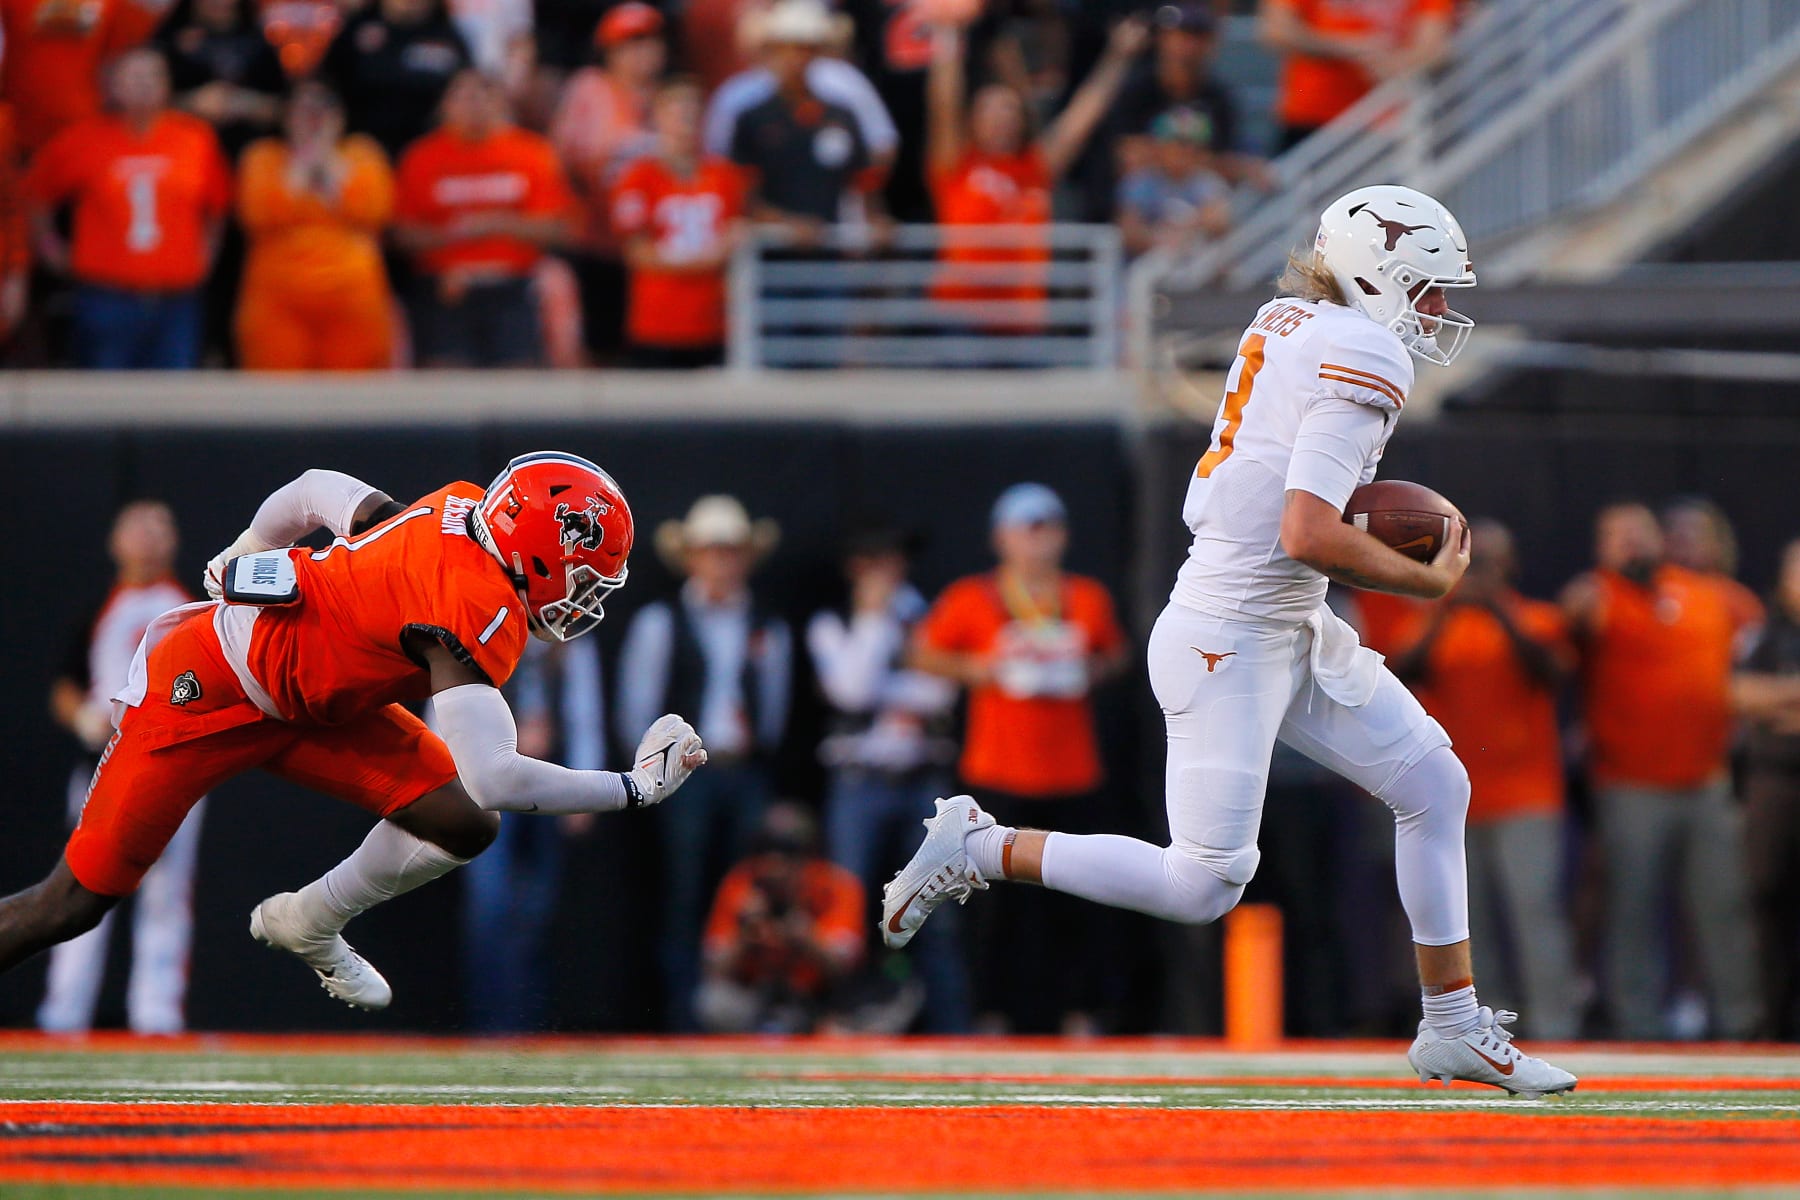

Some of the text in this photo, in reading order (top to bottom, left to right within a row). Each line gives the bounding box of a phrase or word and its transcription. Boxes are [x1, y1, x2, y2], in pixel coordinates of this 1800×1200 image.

[1197, 333, 1267, 478] 3
[310, 507, 434, 561] 1
[252, 557, 279, 585] DOUGLAS
[478, 606, 509, 645] 1
